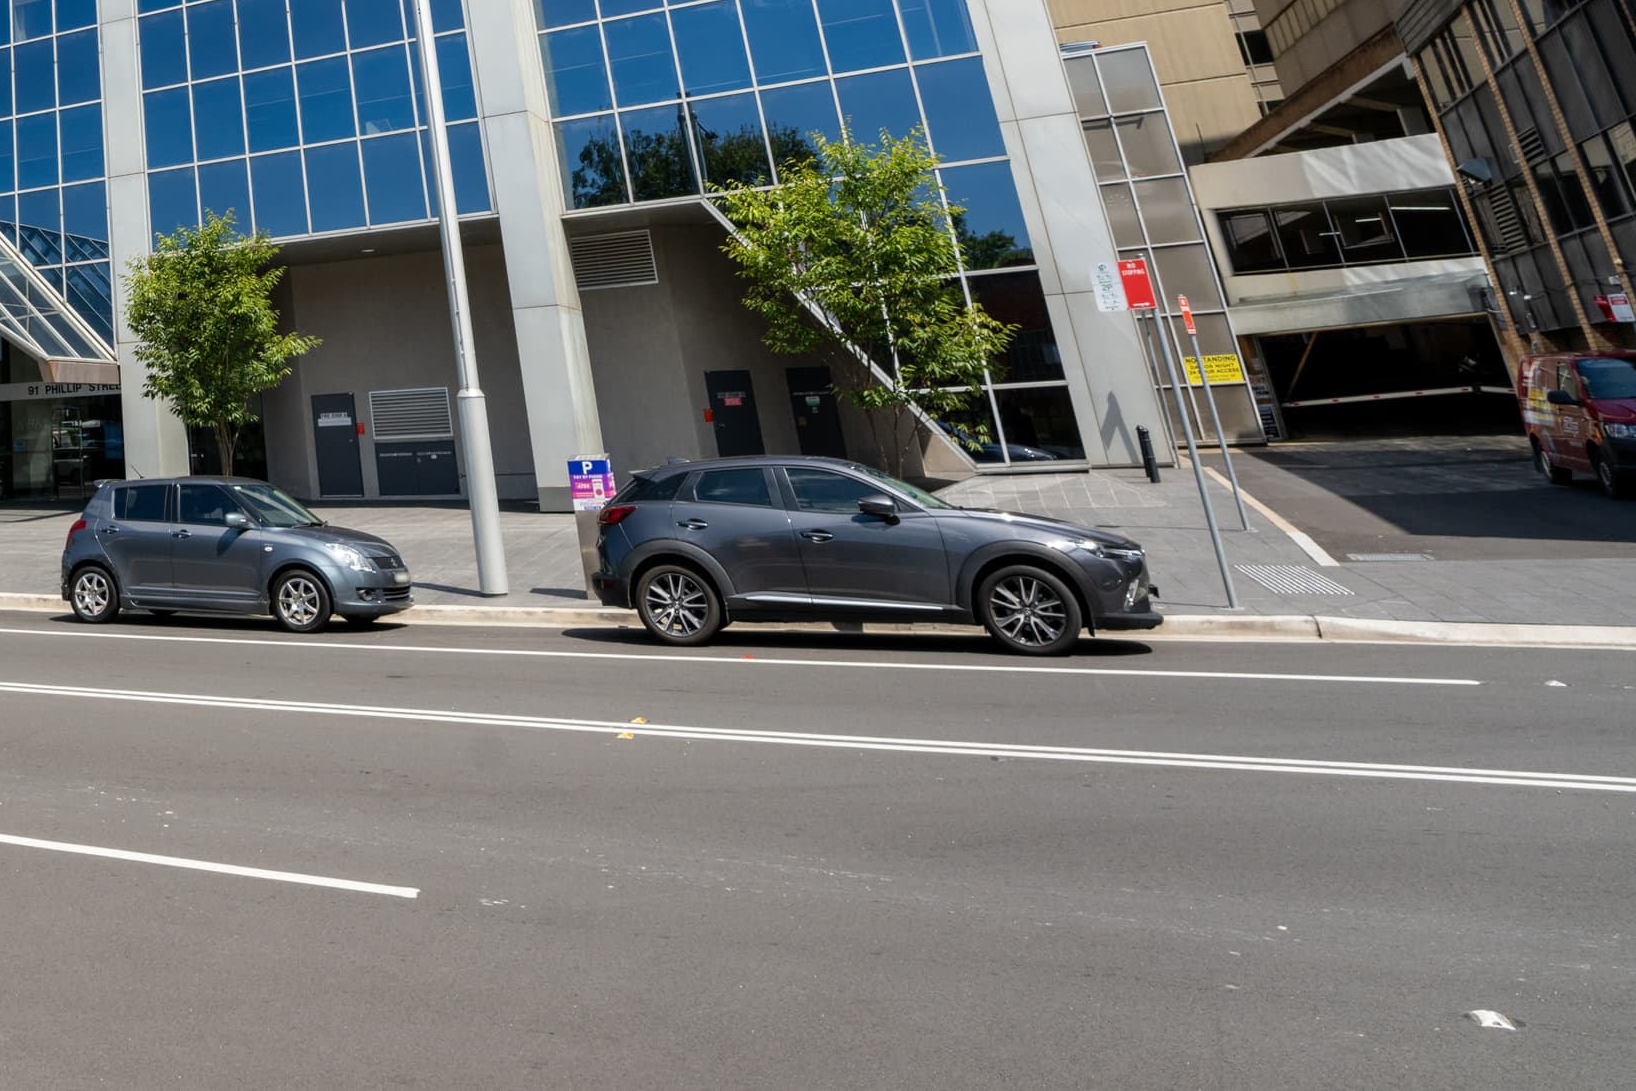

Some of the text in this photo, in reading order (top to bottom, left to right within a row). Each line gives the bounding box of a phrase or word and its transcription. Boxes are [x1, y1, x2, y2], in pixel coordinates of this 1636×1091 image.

[1202, 355, 1237, 363] TANDING
[27, 385, 39, 396] 91
[45, 382, 82, 395] PHILLIP
[581, 461, 593, 475] P
